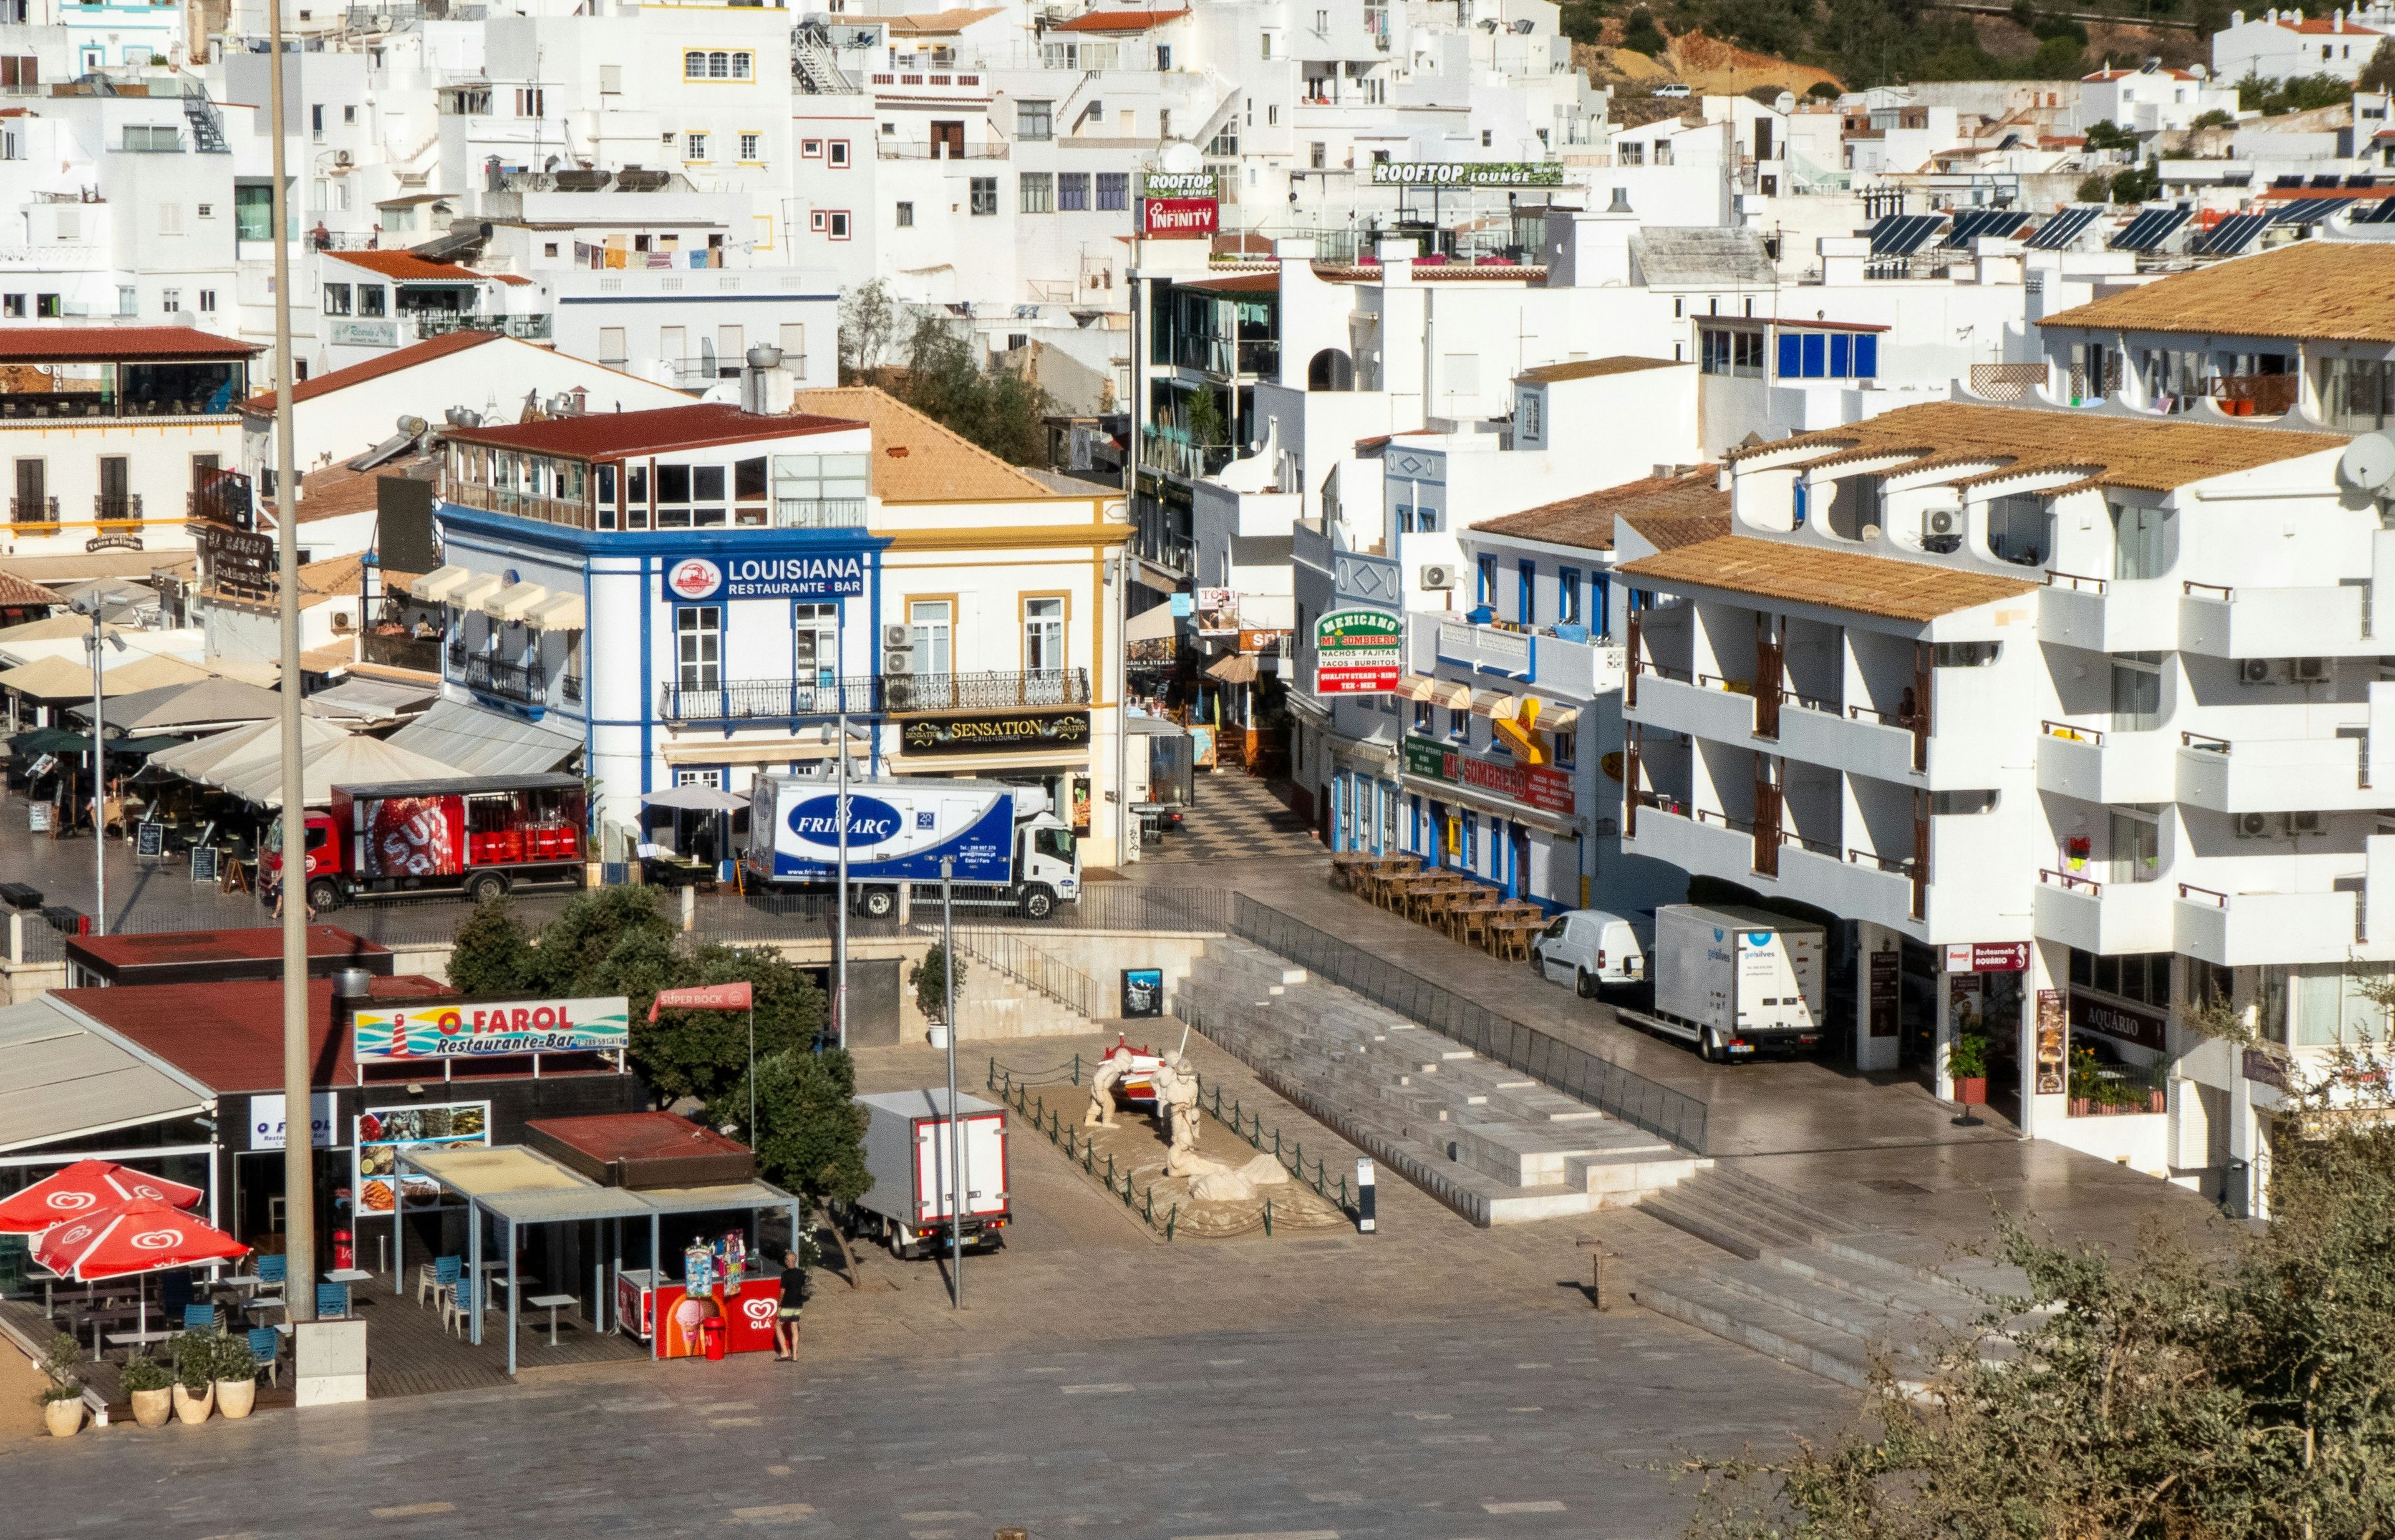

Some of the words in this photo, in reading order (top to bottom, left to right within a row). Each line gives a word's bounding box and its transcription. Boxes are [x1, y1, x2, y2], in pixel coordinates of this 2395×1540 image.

[1375, 163, 1464, 182] ROOFTOP
[1469, 172, 1531, 182] LOUNGE
[1149, 175, 1214, 189] ROOFTOP
[1151, 210, 1212, 228] INFINITY
[728, 558, 861, 581] LOUISIANA
[728, 582, 825, 594] RESTAURANTE
[834, 581, 860, 592] BAR
[1322, 614, 1396, 634] MEXICANO
[1321, 636, 1335, 646] MI
[1341, 635, 1397, 646] SOMBRERO
[905, 731, 941, 739] SENSATIO
[951, 719, 1042, 739] SENSATION
[1464, 758, 1526, 798] SOMBRERO
[1744, 950, 1775, 959] gelsilves
[1975, 948, 2015, 956] Restaurante
[1975, 956, 2008, 966] AQUÁRIO
[660, 994, 692, 1005] SUPER
[694, 994, 722, 1004] BOCK
[438, 1011, 462, 1036] O
[473, 1005, 574, 1034] FAROL
[2088, 1006, 2139, 1037] AQUÁRIO
[437, 1033, 575, 1053] Restaurante-Bar
[257, 1122, 268, 1133] O
[276, 1120, 331, 1133] FOL
[750, 1317, 771, 1330] OLÁ
